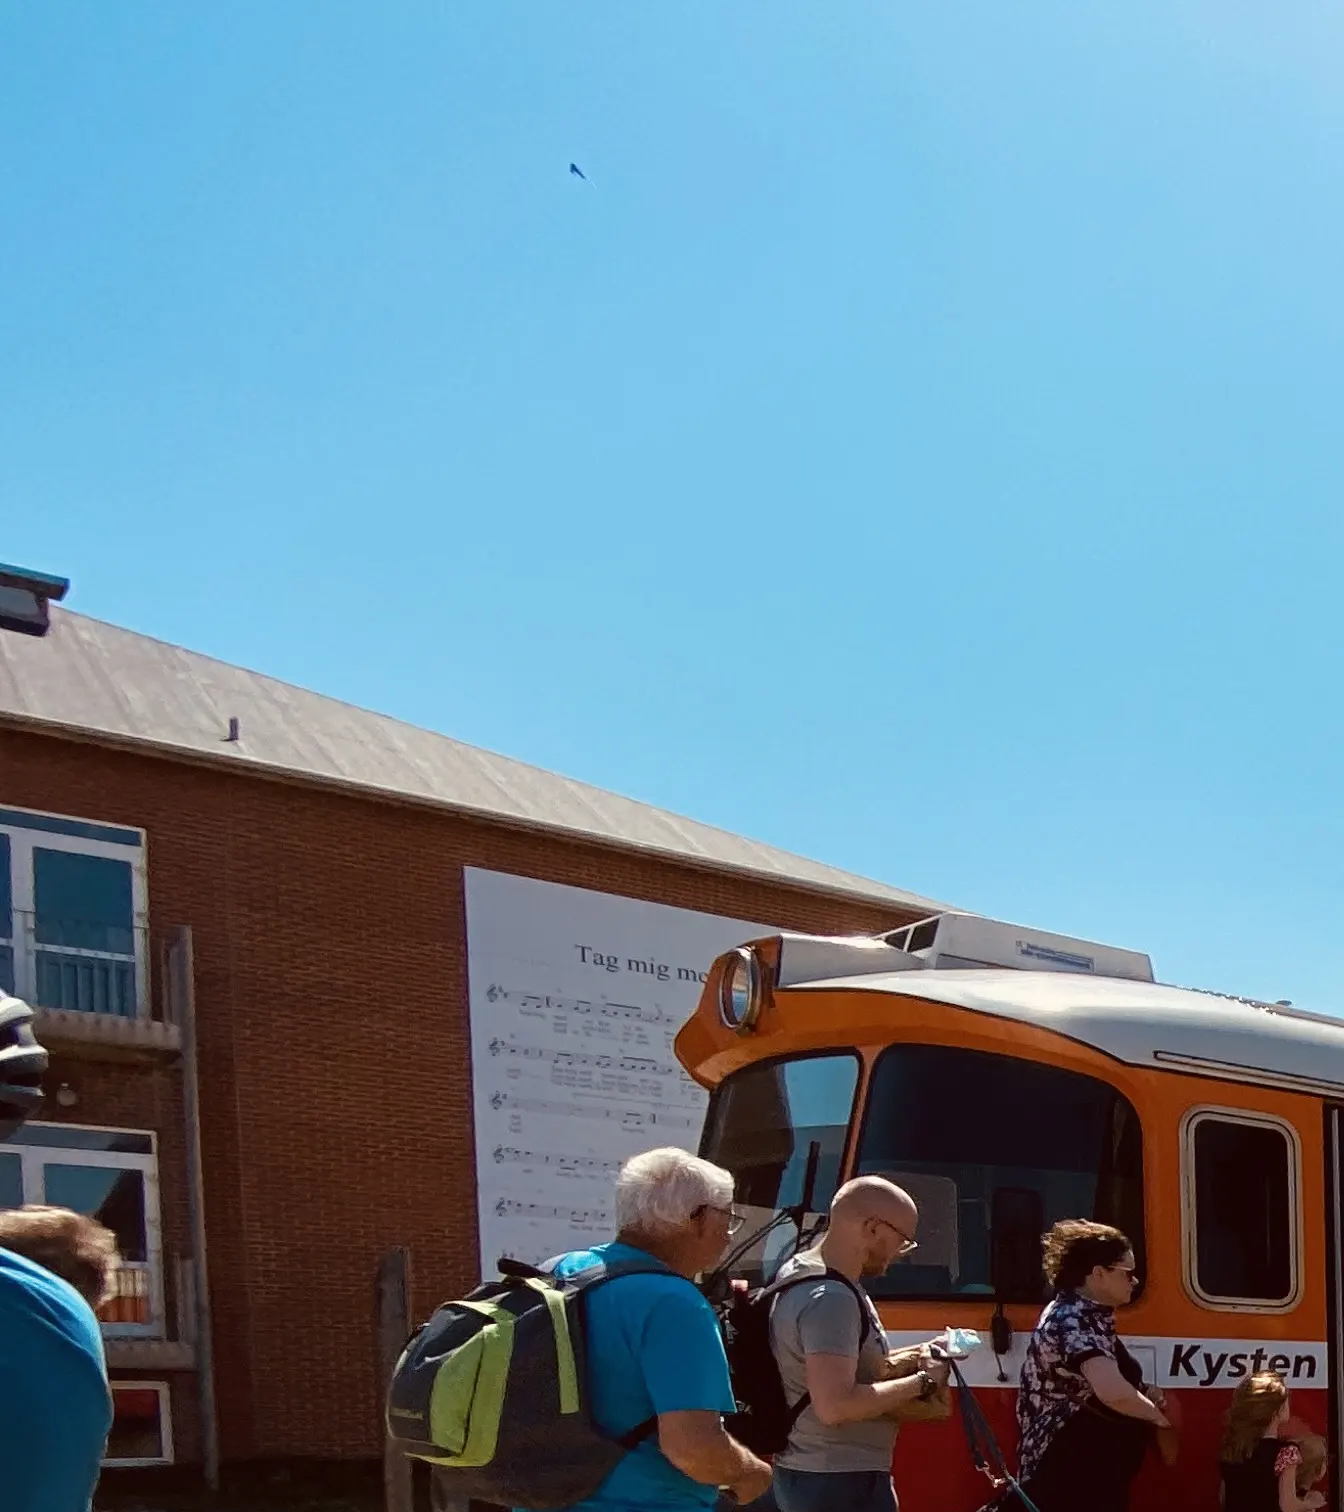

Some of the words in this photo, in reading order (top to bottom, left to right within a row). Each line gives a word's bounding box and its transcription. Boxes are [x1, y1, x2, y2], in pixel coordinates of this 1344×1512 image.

[574, 944, 620, 973] Tag
[627, 956, 671, 982] mig
[1169, 1344, 1317, 1386] Kysten
